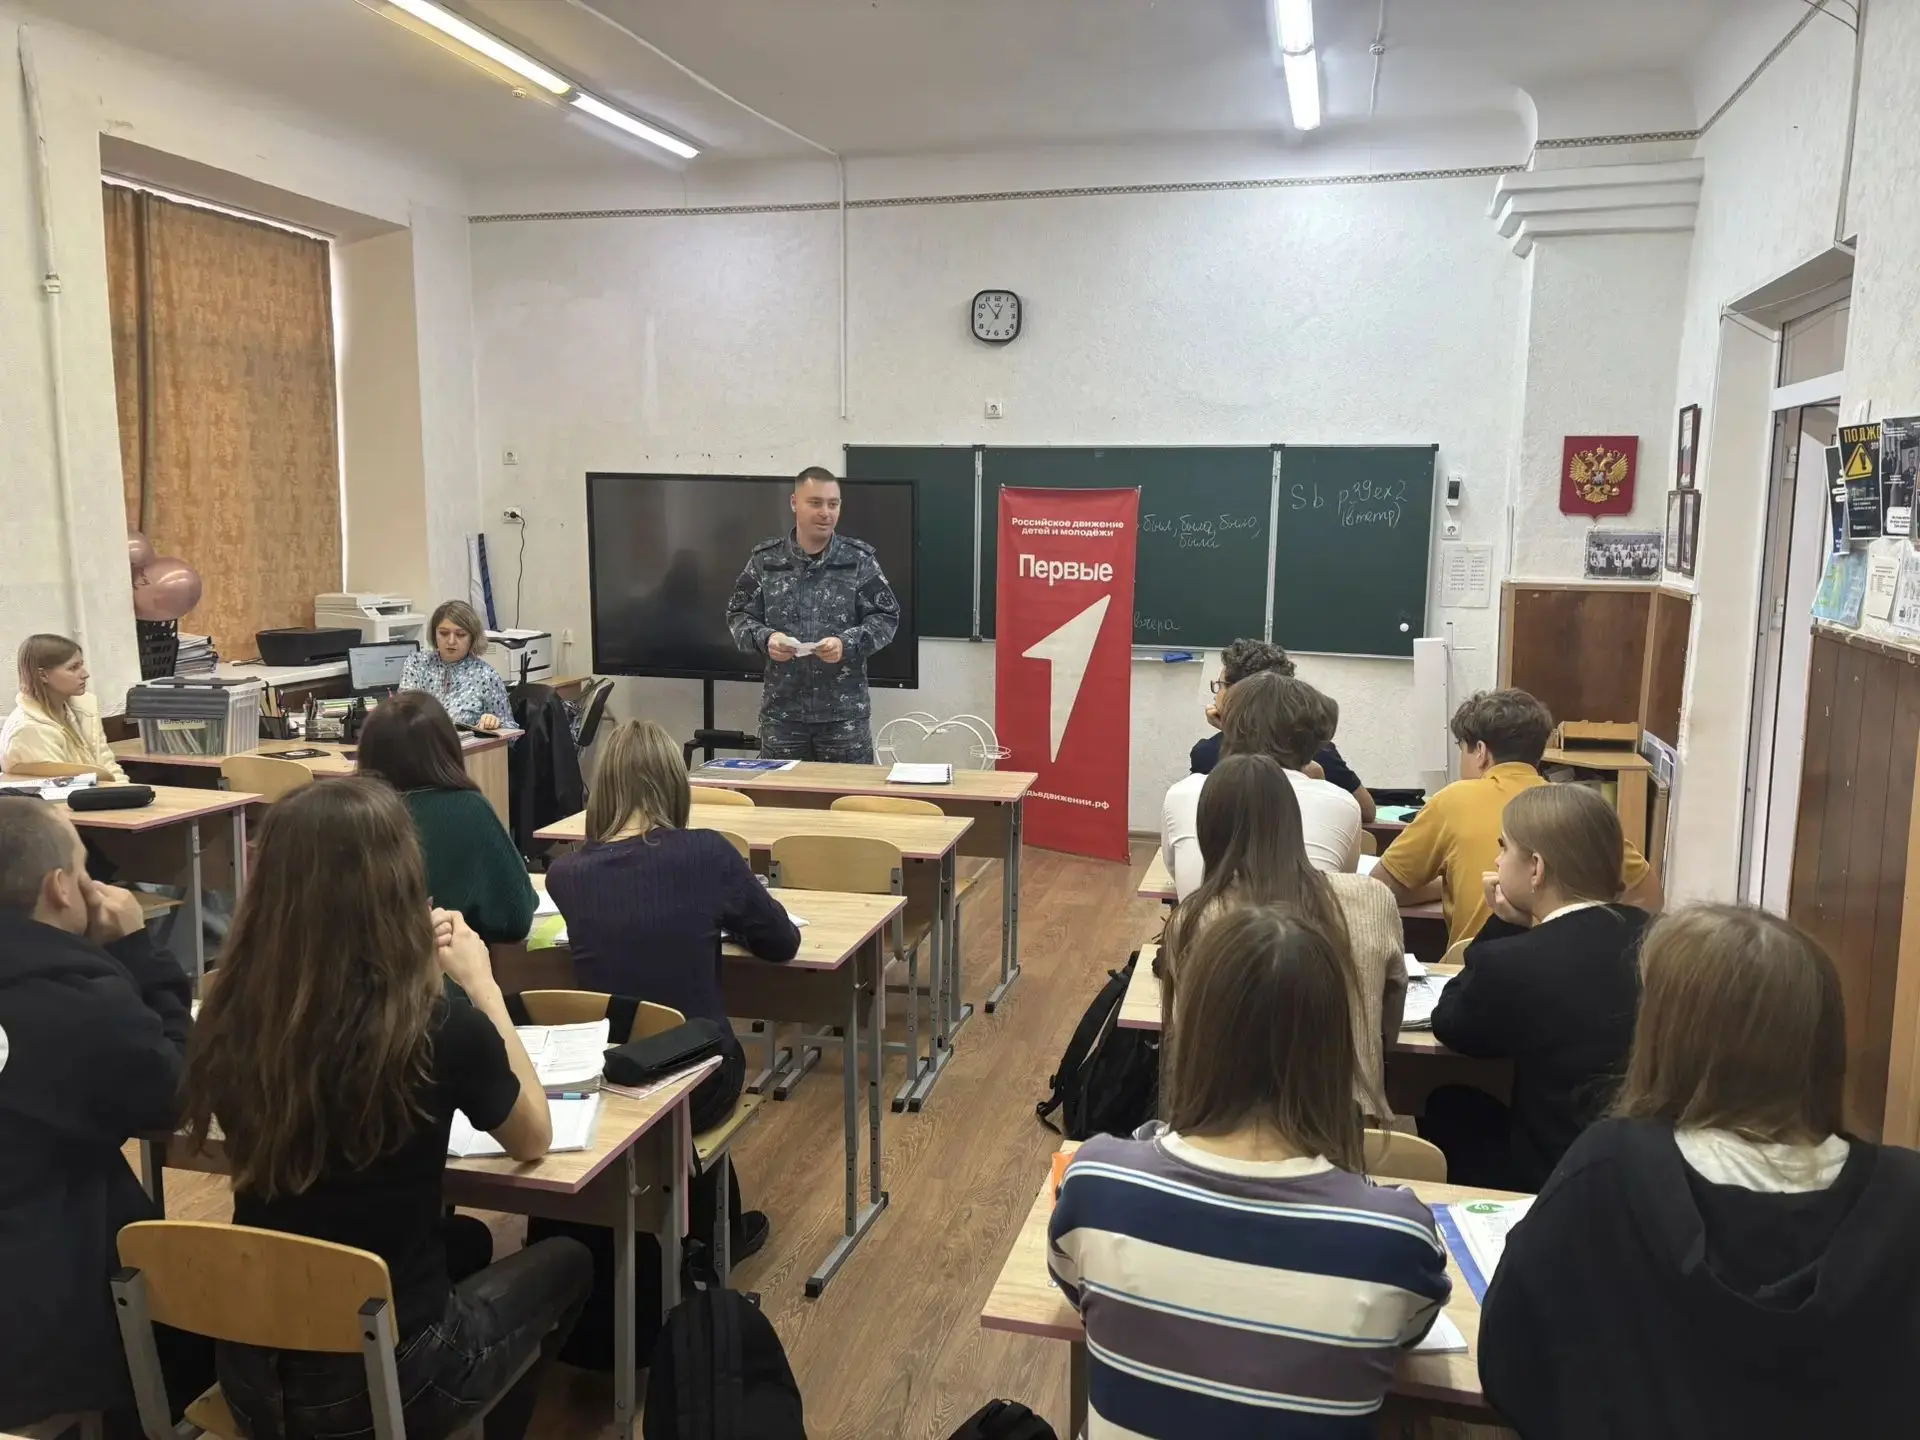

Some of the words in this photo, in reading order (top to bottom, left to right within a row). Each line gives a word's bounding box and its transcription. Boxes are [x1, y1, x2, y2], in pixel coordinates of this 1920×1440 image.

[1012, 517, 1071, 528] Российское
[1072, 520, 1124, 529] движение
[1022, 527, 1050, 536] детей
[1060, 528, 1114, 537] молодёжи
[1019, 553, 1114, 587] Первые
[1025, 790, 1110, 810] дьвдвижении.рф
